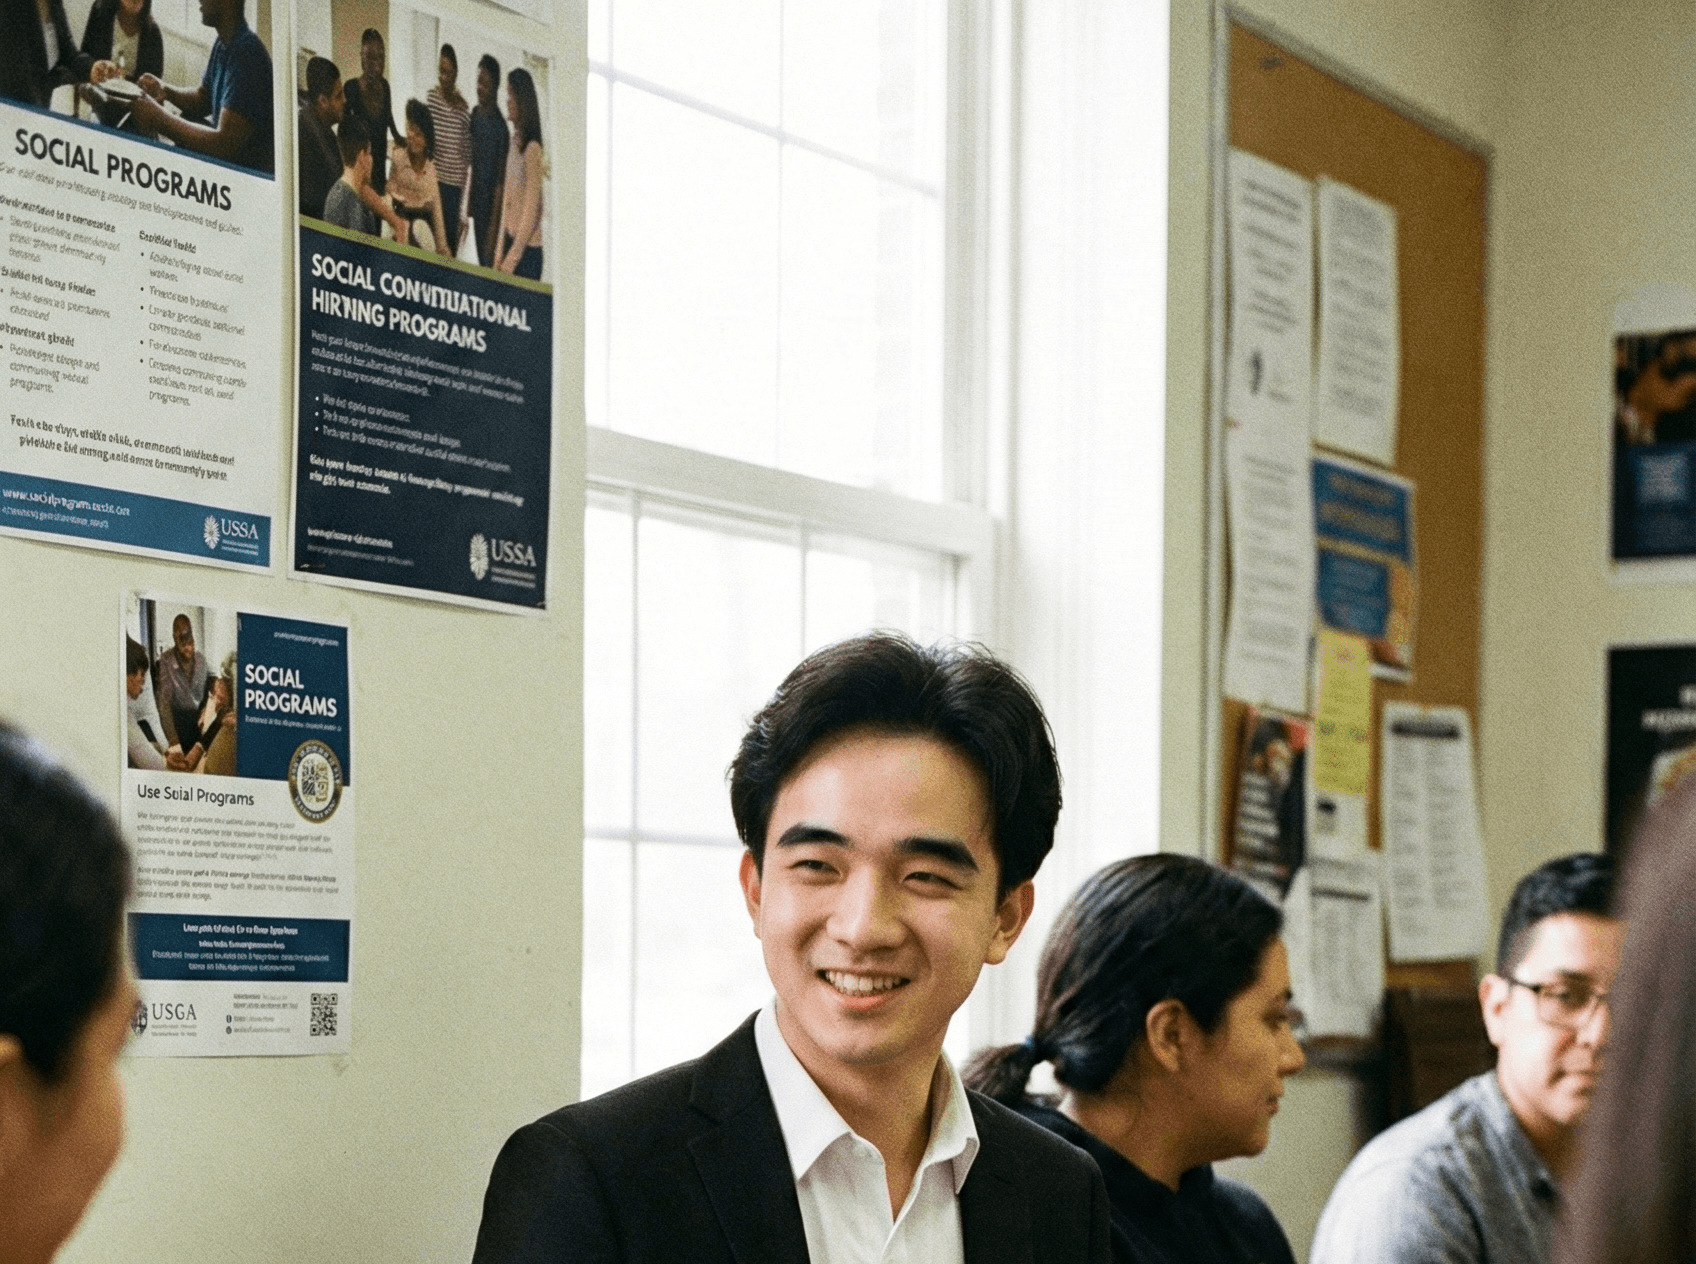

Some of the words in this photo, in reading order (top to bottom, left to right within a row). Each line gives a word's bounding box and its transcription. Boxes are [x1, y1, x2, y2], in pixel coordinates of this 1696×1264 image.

[15, 128, 99, 175] SOCIAL
[107, 153, 232, 211] PROGRAMS
[311, 253, 375, 291] SOCIAL
[388, 307, 487, 353] PROGRAMS
[221, 518, 259, 540] USSA
[490, 538, 537, 568] USSA
[244, 663, 305, 690] SOCIAL
[244, 689, 338, 718] PROGRAMS
[137, 784, 161, 799] Use
[197, 788, 255, 807] Programs
[152, 1003, 197, 1021] USGA
